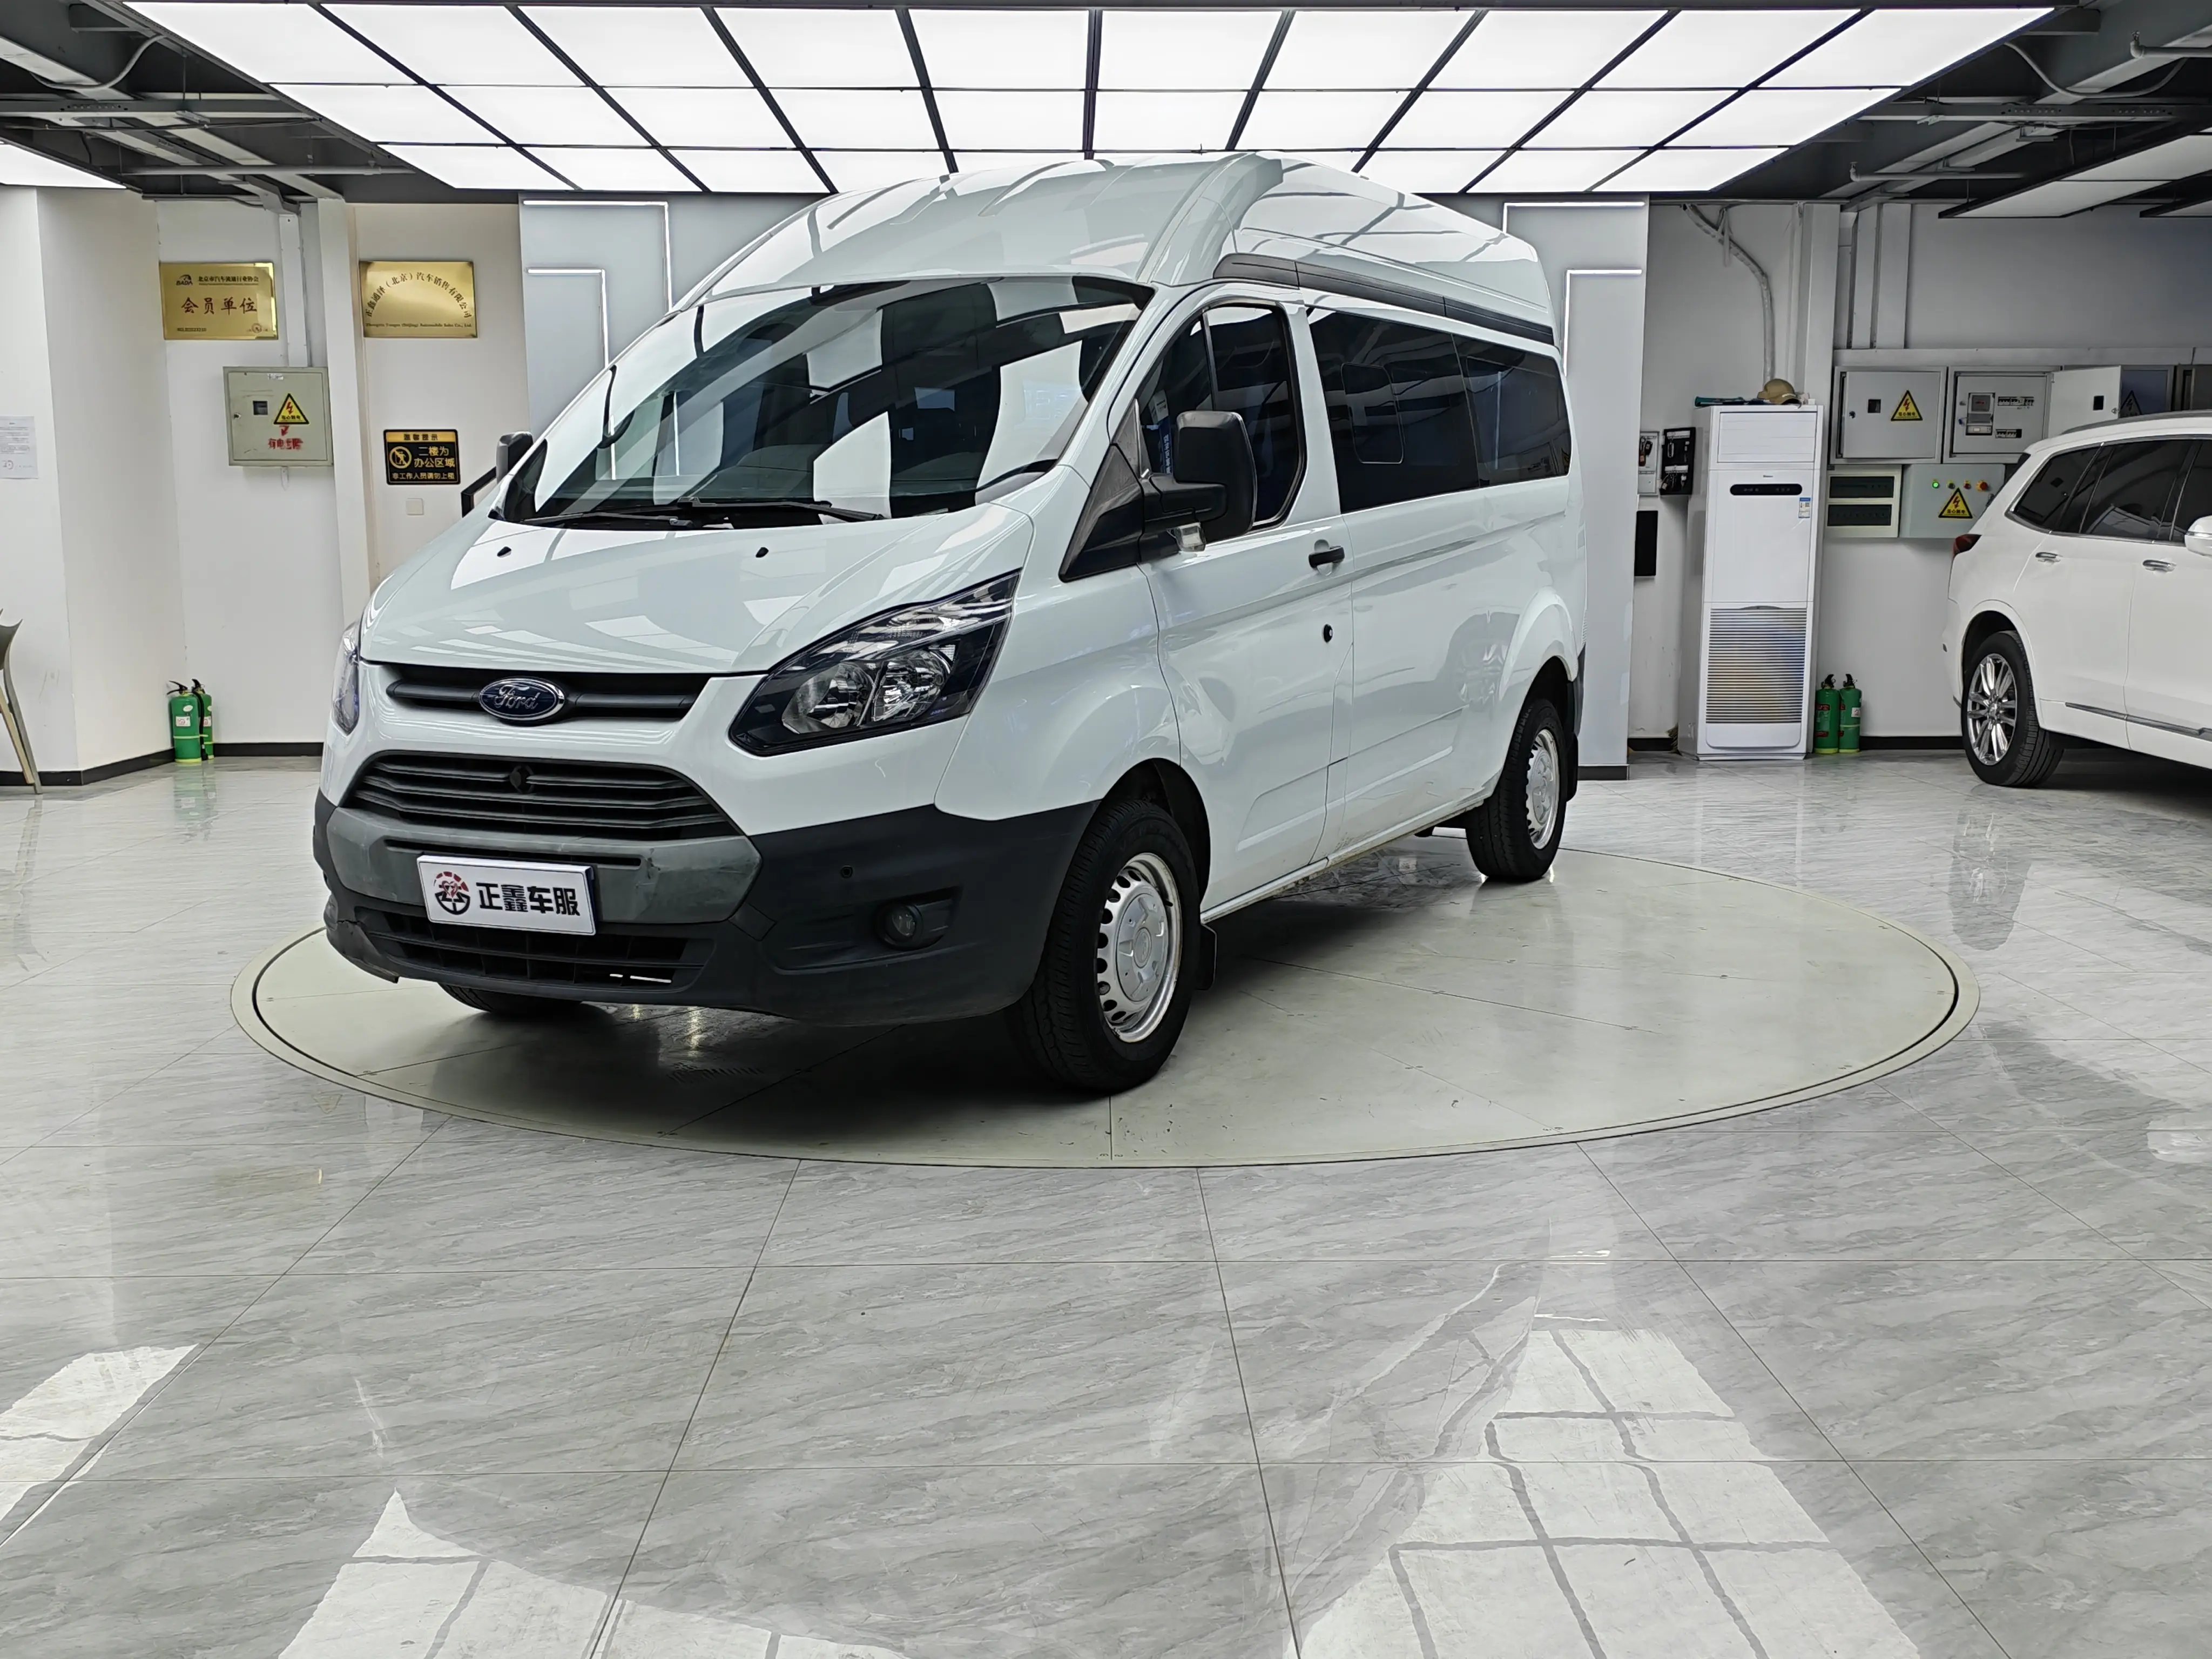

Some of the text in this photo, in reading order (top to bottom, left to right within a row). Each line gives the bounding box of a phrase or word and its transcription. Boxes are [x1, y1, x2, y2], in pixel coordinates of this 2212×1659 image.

[181, 296, 258, 315] 会员单位
[419, 446, 449, 456] 二楼为
[414, 457, 455, 468] 办公区域
[494, 684, 541, 710] Ford
[475, 882, 581, 916] 正鑫车服
